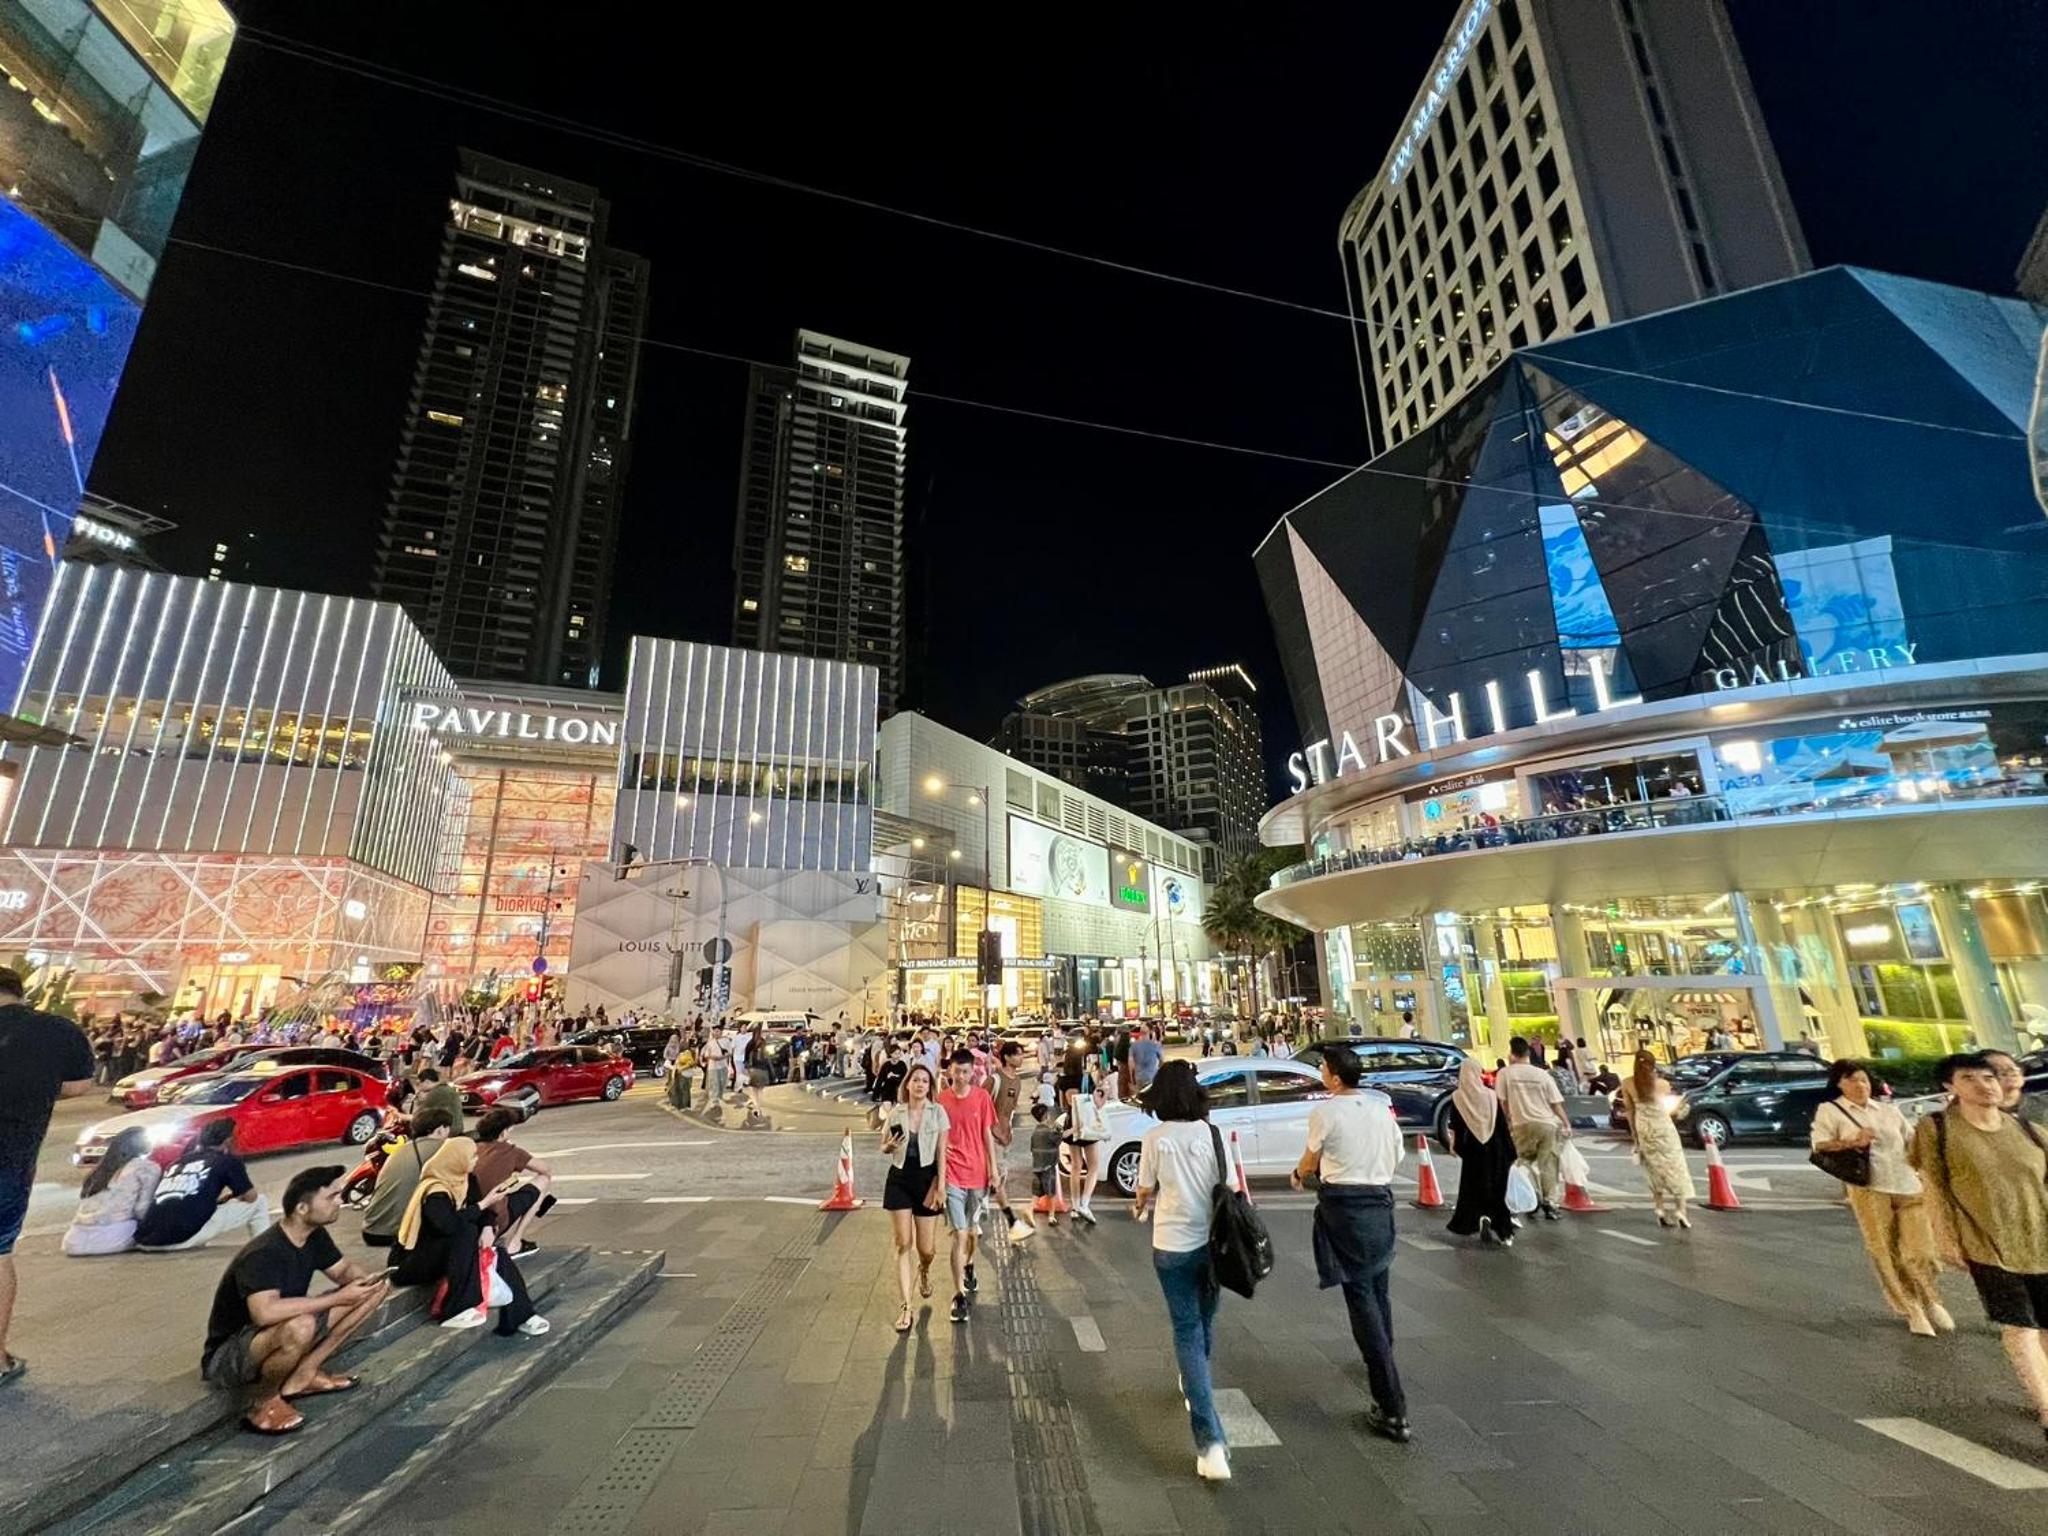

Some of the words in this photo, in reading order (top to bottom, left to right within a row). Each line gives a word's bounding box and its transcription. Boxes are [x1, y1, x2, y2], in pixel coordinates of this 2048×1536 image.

[1715, 642, 1919, 691] GALLERY
[411, 703, 619, 745] PAVILION
[1287, 655, 1644, 795] STARHILL
[619, 941, 661, 953] LOUIS
